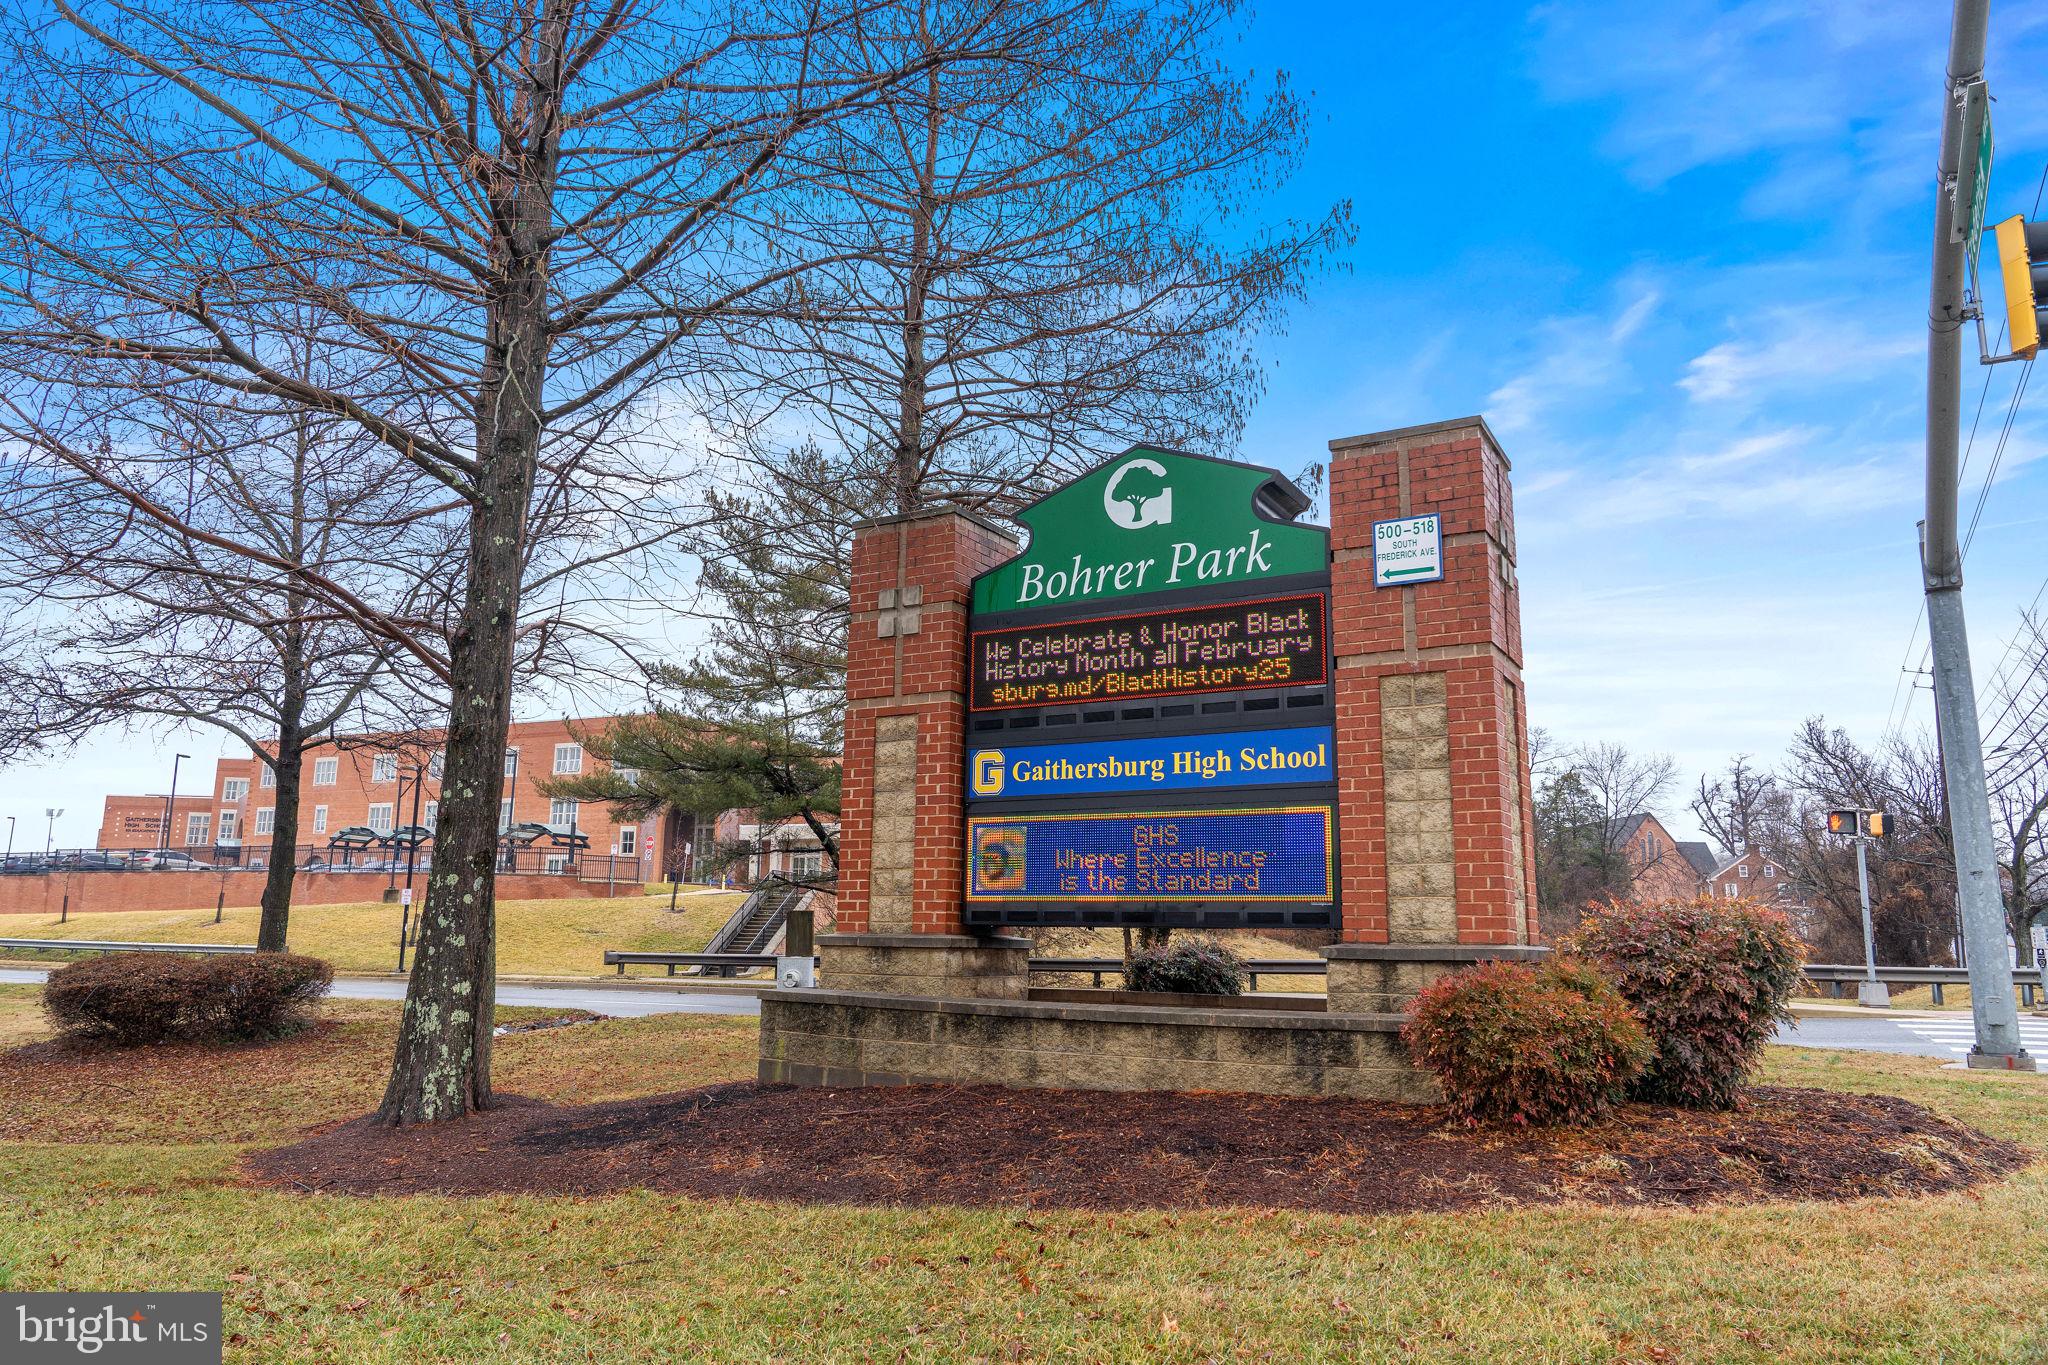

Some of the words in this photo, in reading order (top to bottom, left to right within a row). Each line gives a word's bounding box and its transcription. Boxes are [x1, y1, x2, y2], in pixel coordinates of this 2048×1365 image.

[1377, 549, 1418, 562] FREDERICK
[1420, 547, 1435, 557] AVE
[1392, 539, 1418, 550] SOUTH
[1016, 554, 1155, 602] Bohrer
[1165, 528, 1272, 584] Park
[985, 641, 1012, 661] We
[1018, 629, 1132, 658] Celebrate
[1140, 625, 1154, 645] &
[1162, 621, 1238, 643] Honor
[1247, 608, 1309, 634] Black
[985, 658, 1068, 681] History
[1075, 647, 1145, 673] Month
[1153, 643, 1177, 665] all
[1185, 635, 1312, 662] February
[972, 748, 1006, 796] G
[1012, 756, 1165, 782] Gaithersburg
[1171, 749, 1232, 779] High
[1240, 743, 1327, 771] School
[1133, 825, 1179, 846] GHS
[1055, 848, 1128, 870] Where
[1136, 846, 1267, 869] Excellence
[1060, 873, 1079, 892] is
[1086, 870, 1128, 892] the
[1136, 869, 1260, 892] Standard
